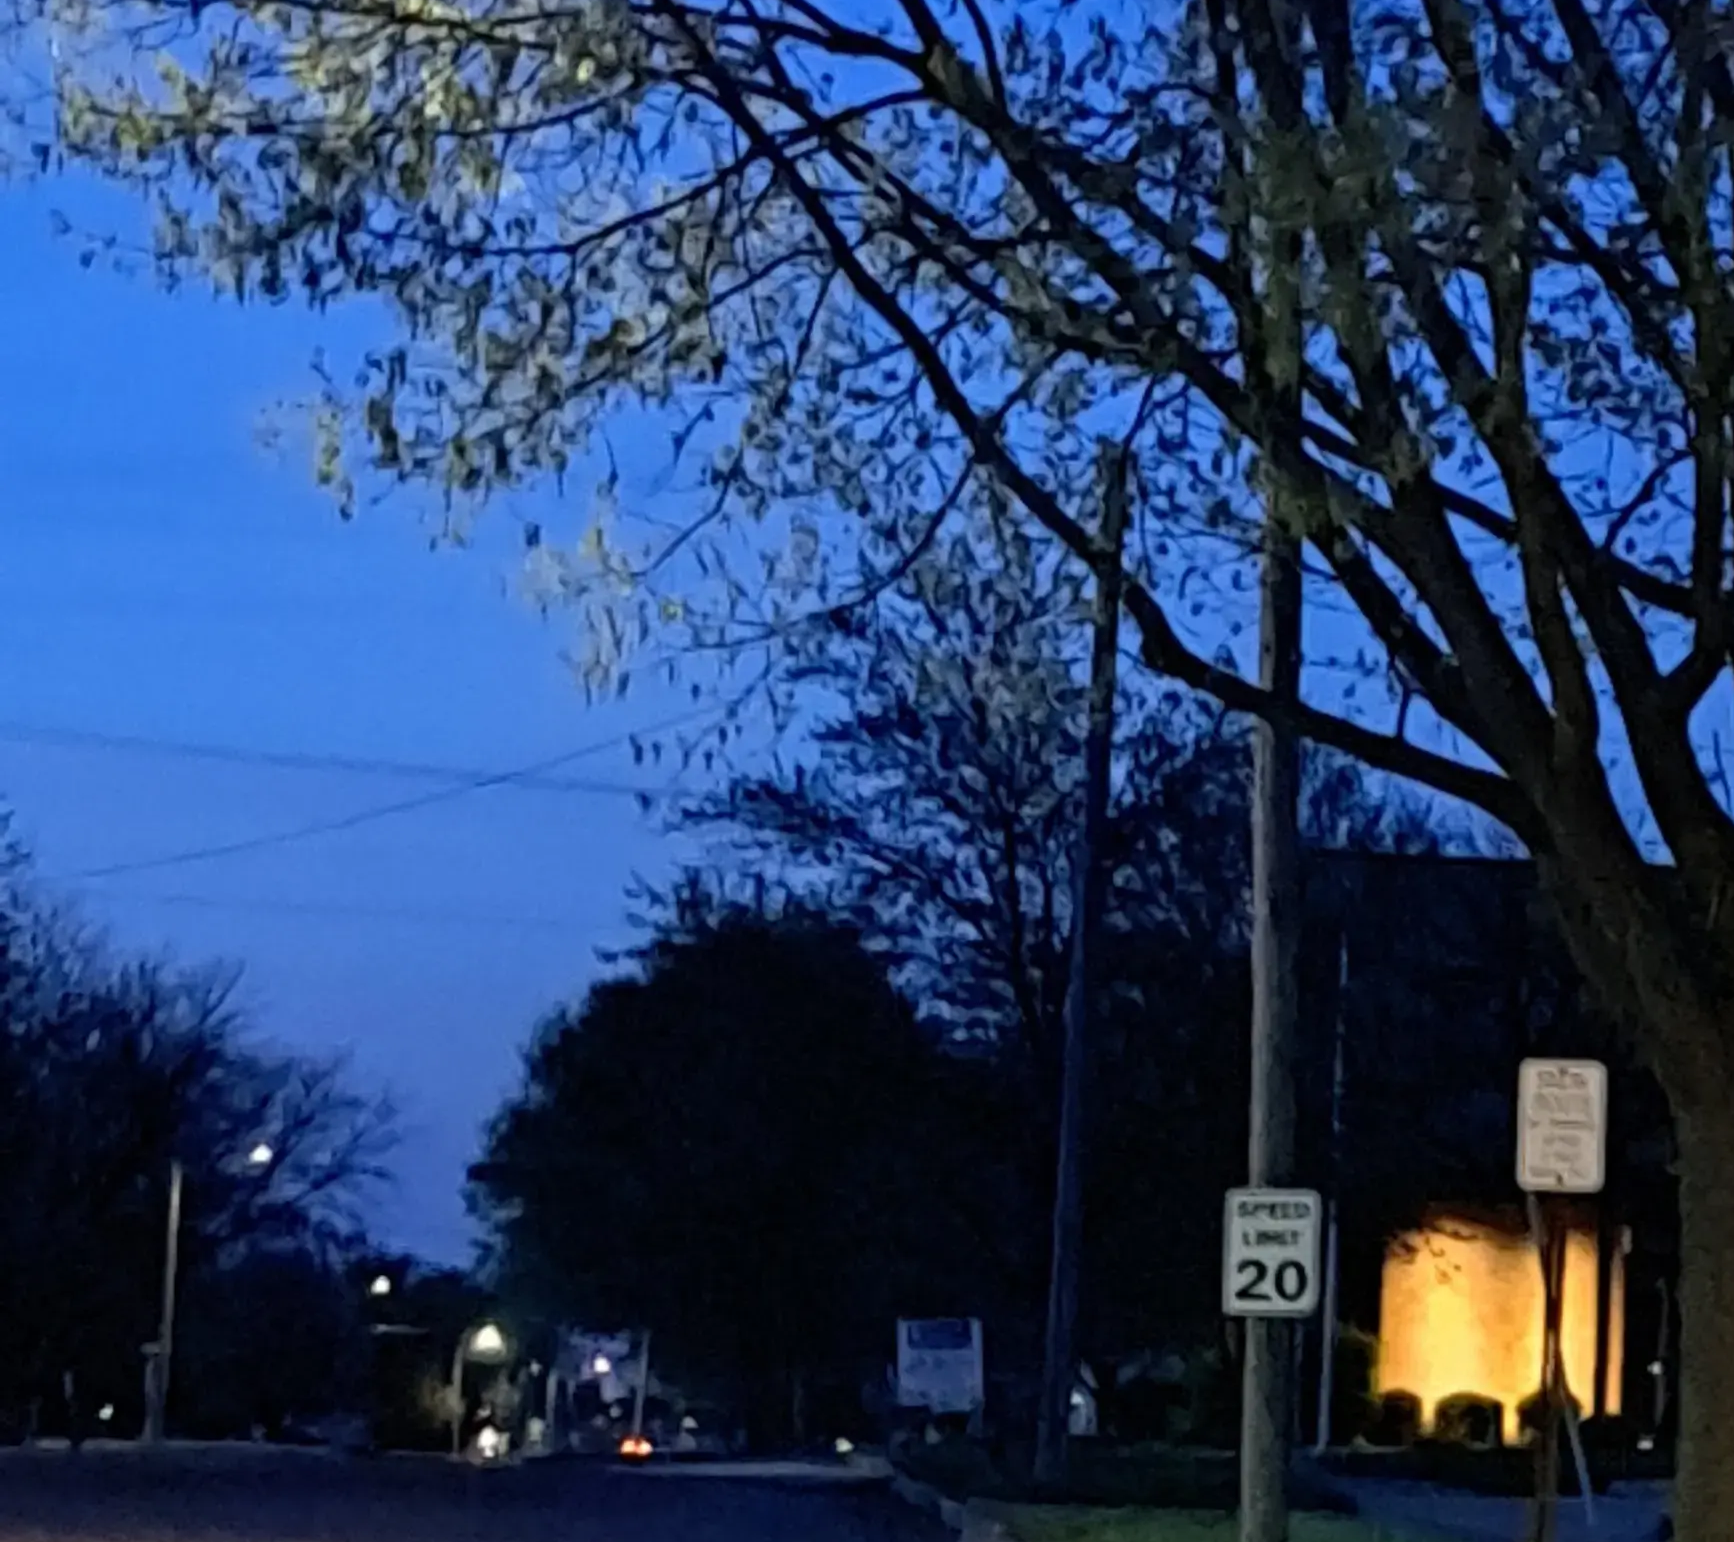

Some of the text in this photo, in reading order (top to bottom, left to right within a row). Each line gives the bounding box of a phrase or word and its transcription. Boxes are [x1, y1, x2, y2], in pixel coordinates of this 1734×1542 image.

[1237, 1201, 1311, 1220] SPEED
[1241, 1229, 1304, 1247] LIMIT
[1235, 1259, 1309, 1302] 20
